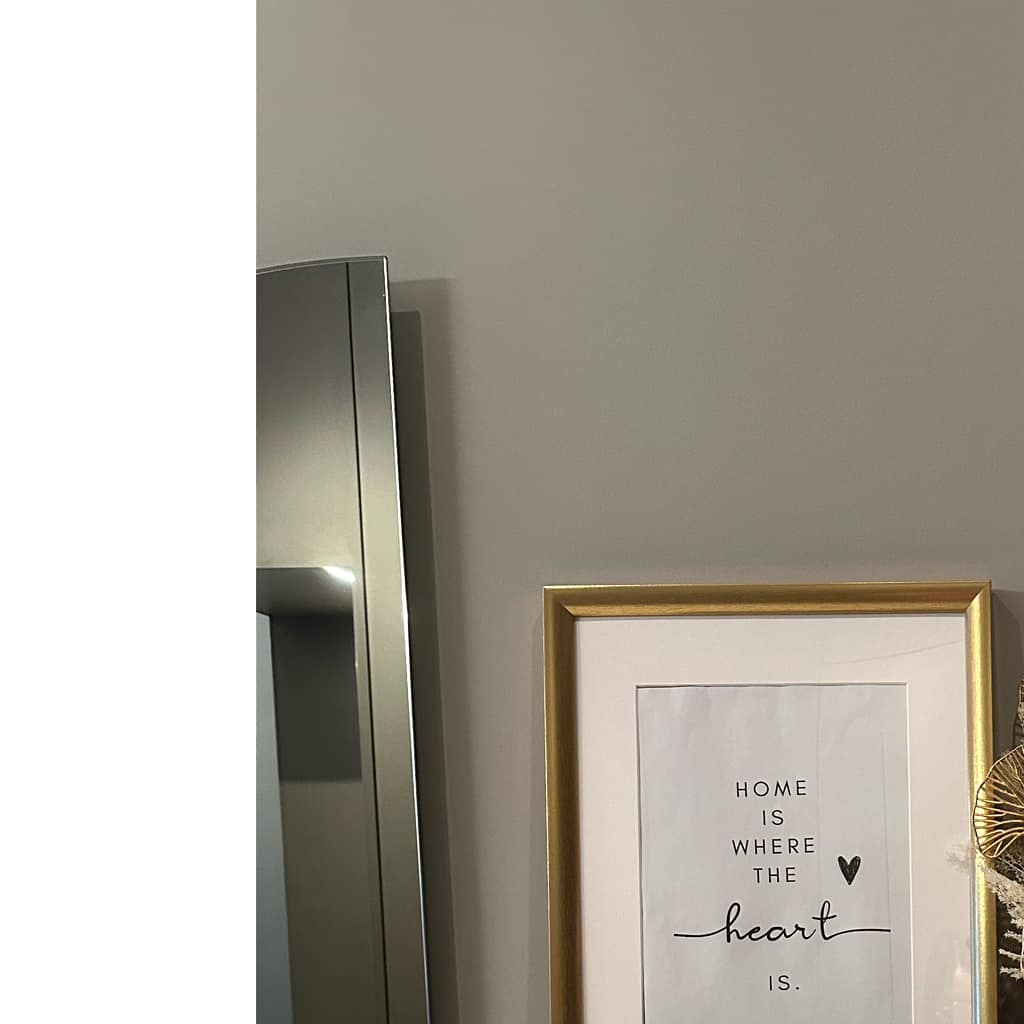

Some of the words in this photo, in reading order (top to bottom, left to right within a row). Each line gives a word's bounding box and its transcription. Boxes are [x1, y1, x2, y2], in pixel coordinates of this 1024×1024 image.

[735, 779, 807, 798] HOME
[762, 809, 784, 827] IS
[731, 837, 816, 857] WHERE
[752, 866, 797, 884] THE
[673, 899, 892, 944] heart
[769, 974, 801, 992] IS.
